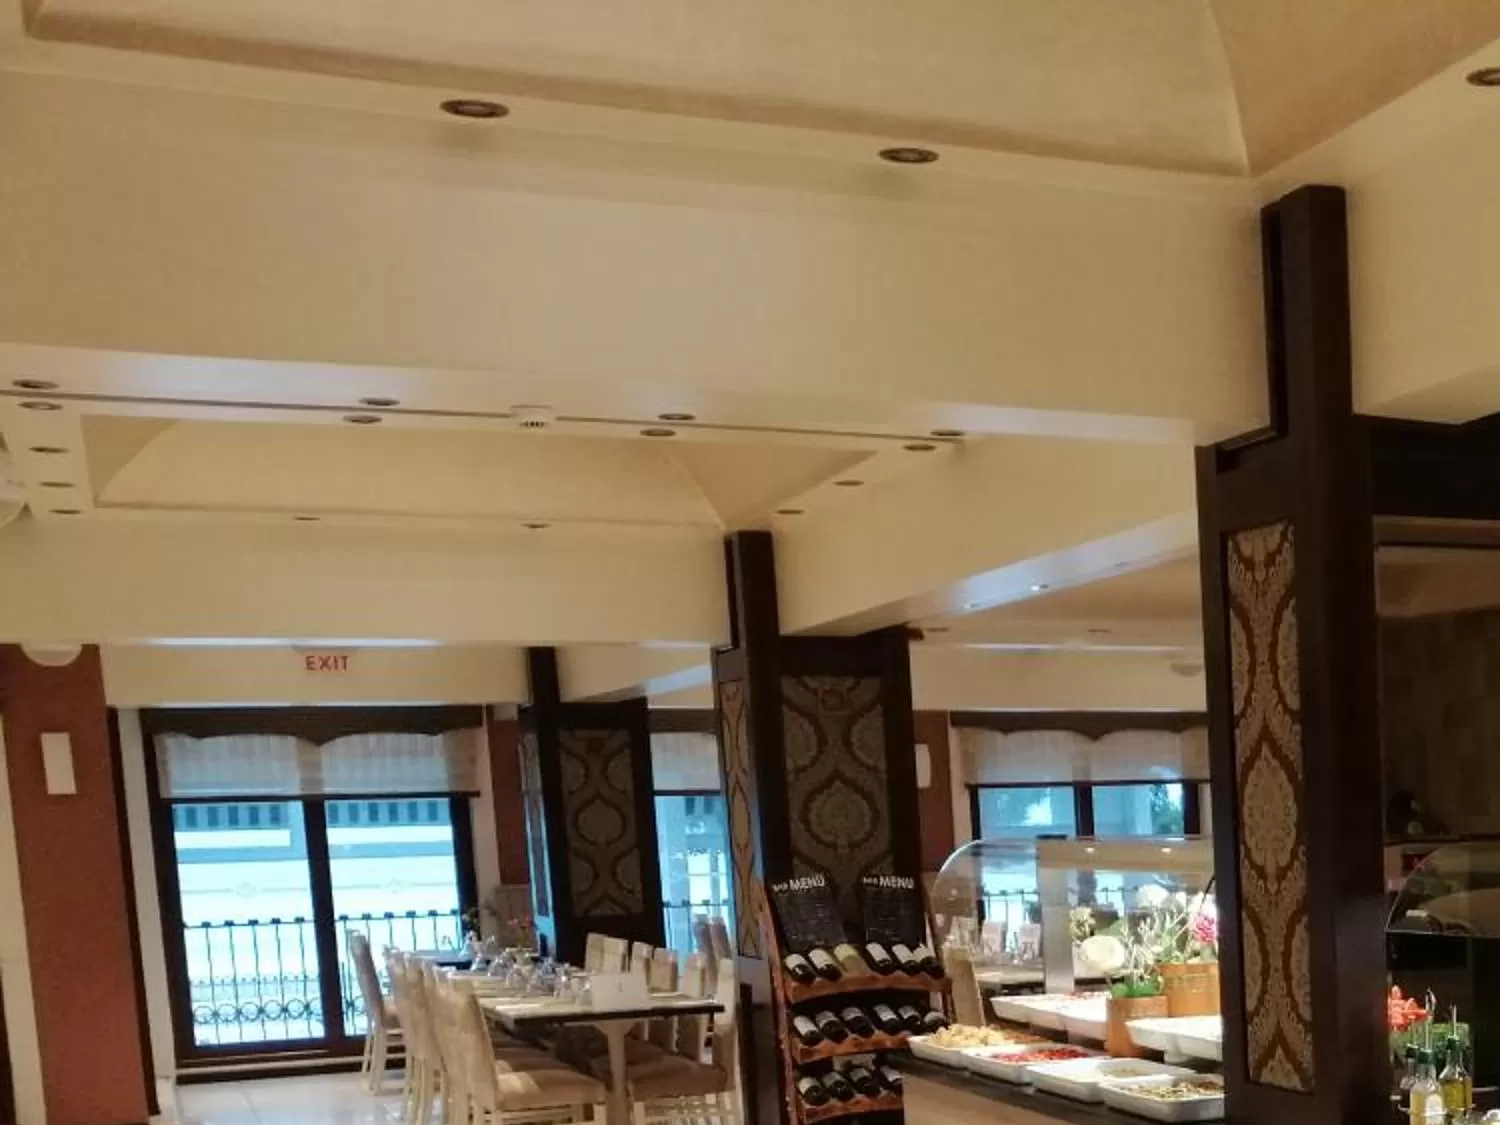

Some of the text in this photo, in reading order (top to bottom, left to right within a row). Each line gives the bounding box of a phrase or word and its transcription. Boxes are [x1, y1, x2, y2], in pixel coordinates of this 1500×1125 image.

[305, 655, 349, 671] EXIT
[789, 874, 825, 891] MENU
[879, 876, 914, 889] MENU
